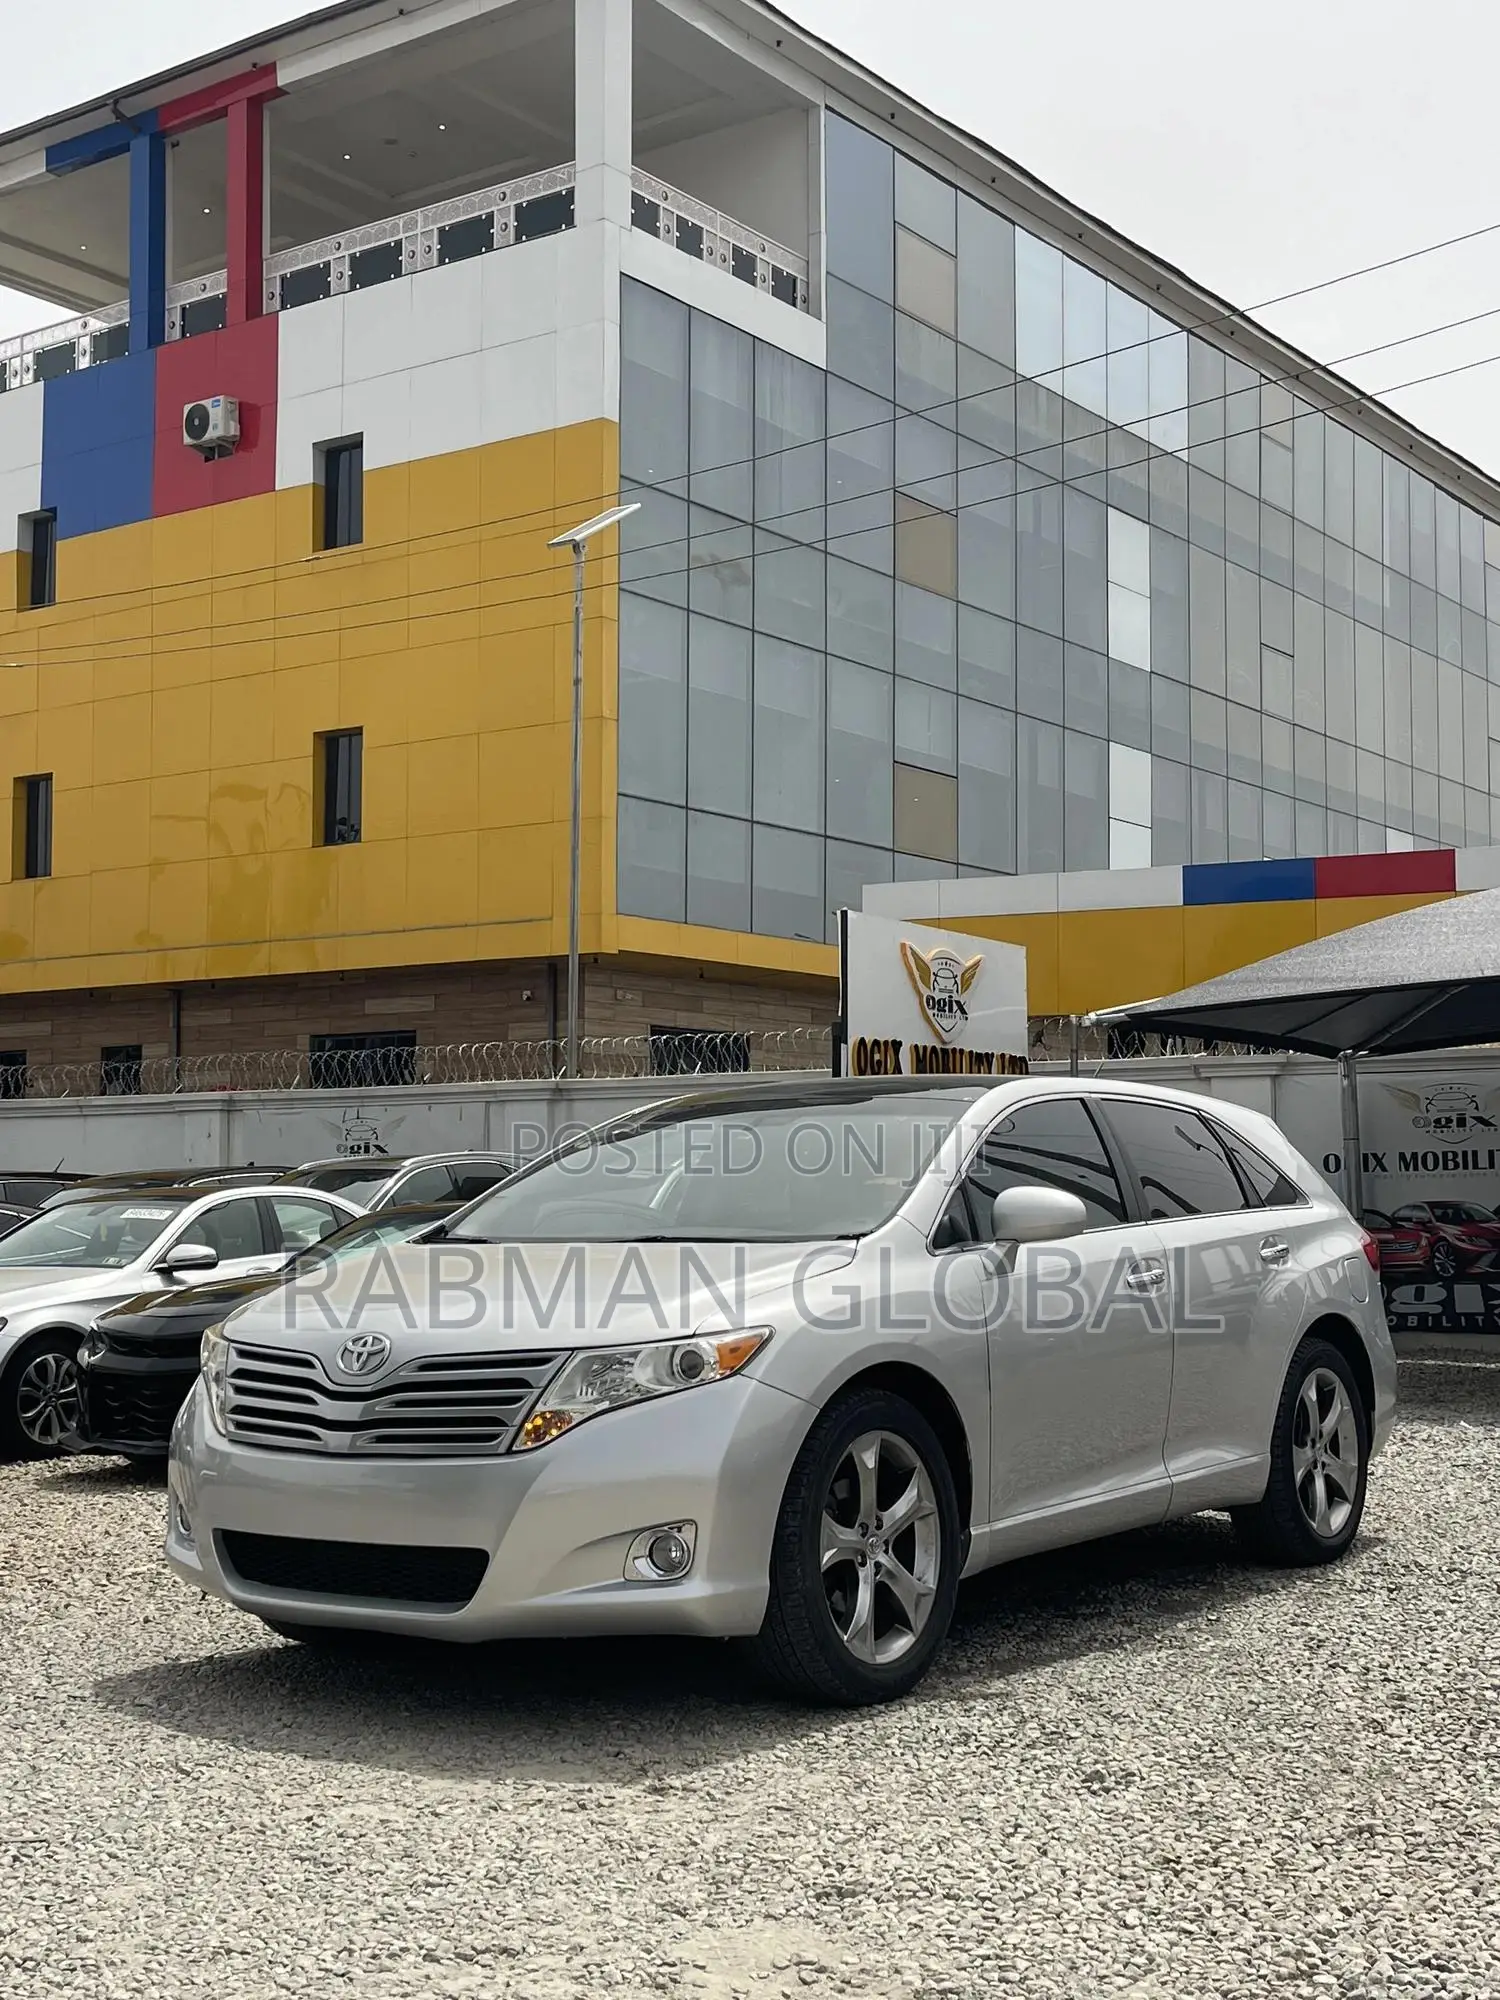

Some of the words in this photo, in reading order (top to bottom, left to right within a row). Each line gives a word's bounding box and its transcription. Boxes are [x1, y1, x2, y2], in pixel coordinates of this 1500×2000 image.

[852, 1036, 903, 1076] OGIX
[1323, 1152, 1389, 1173] OIX
[1399, 1149, 1500, 1172] MOBILI
